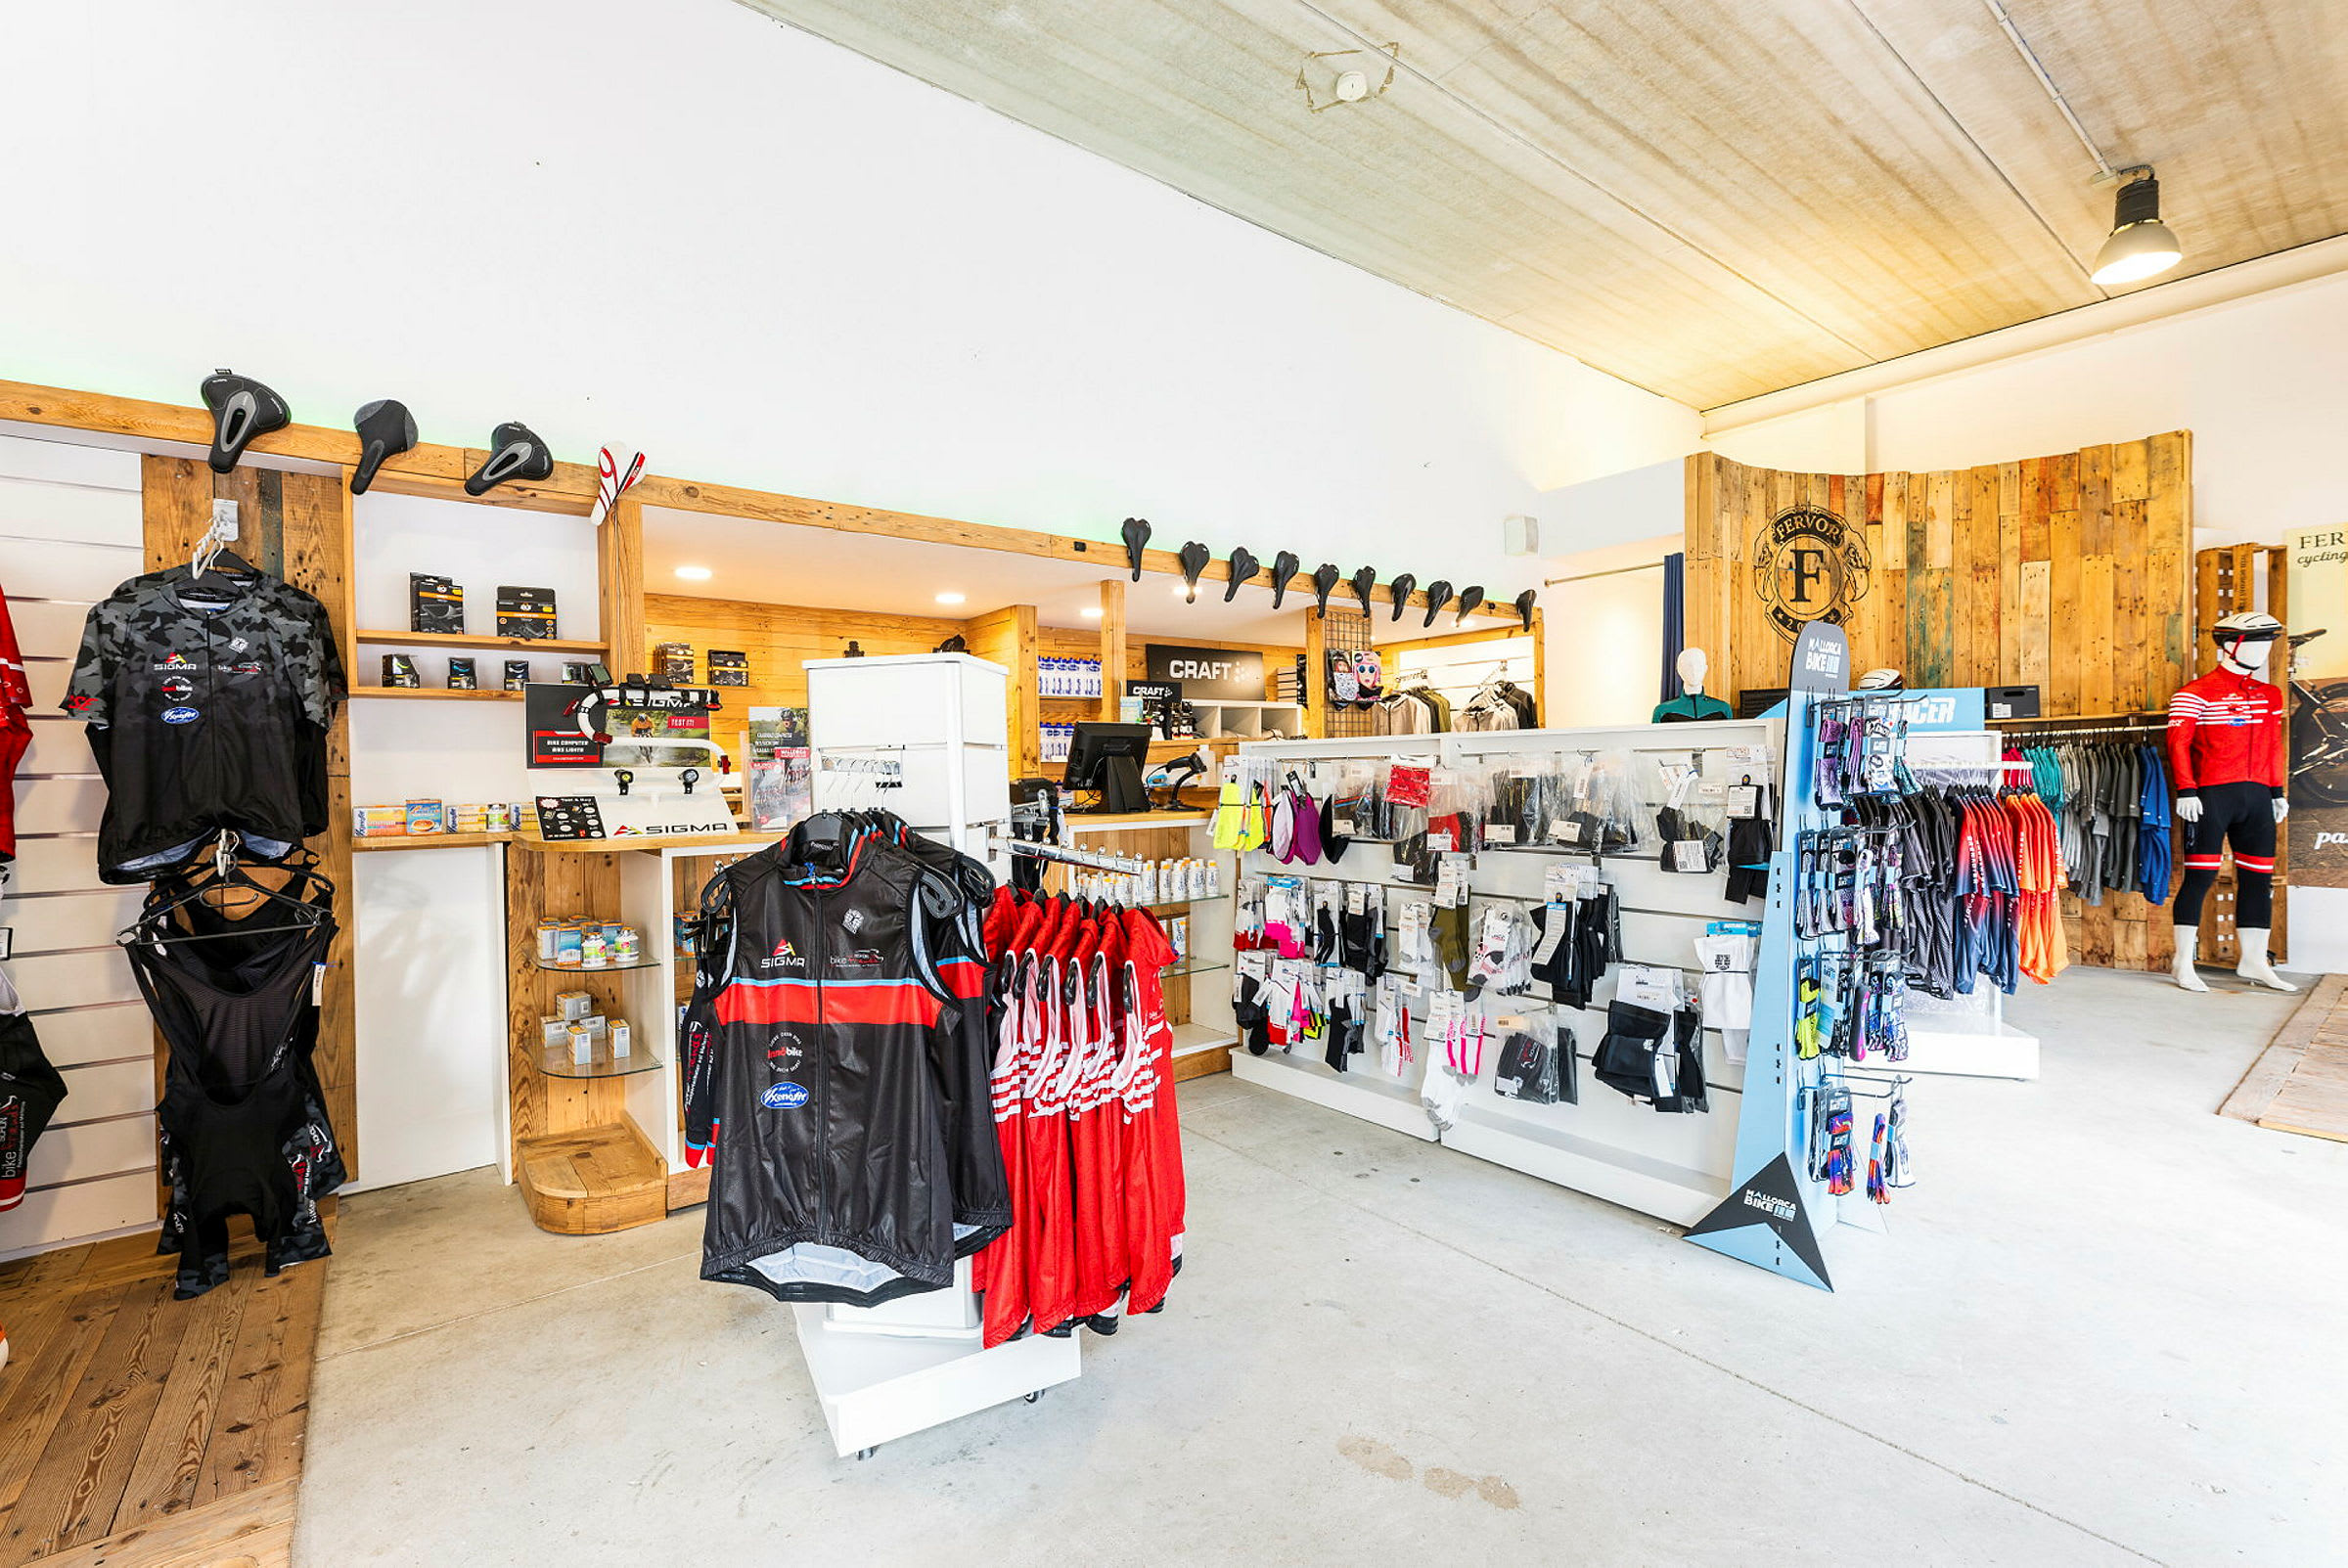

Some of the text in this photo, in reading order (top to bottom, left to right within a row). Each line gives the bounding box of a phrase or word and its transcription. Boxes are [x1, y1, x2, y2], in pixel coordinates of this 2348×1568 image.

[1777, 513, 1841, 540] FERVOR
[2297, 551, 2348, 568] cycling
[1789, 549, 1824, 603] F
[1808, 637, 1841, 655] MALLORCA
[1169, 659, 1233, 680] CRAFT
[1805, 651, 1828, 672] BIKE
[1132, 686, 1165, 695] CRAFT
[646, 823, 728, 834] SIGMA
[2314, 831, 2348, 850] pa
[760, 956, 805, 968] SIGMA
[2, 1151, 17, 1178] bike
[1743, 1195, 1775, 1213] BIKE
[1746, 1188, 1797, 1210] MALLORCA
